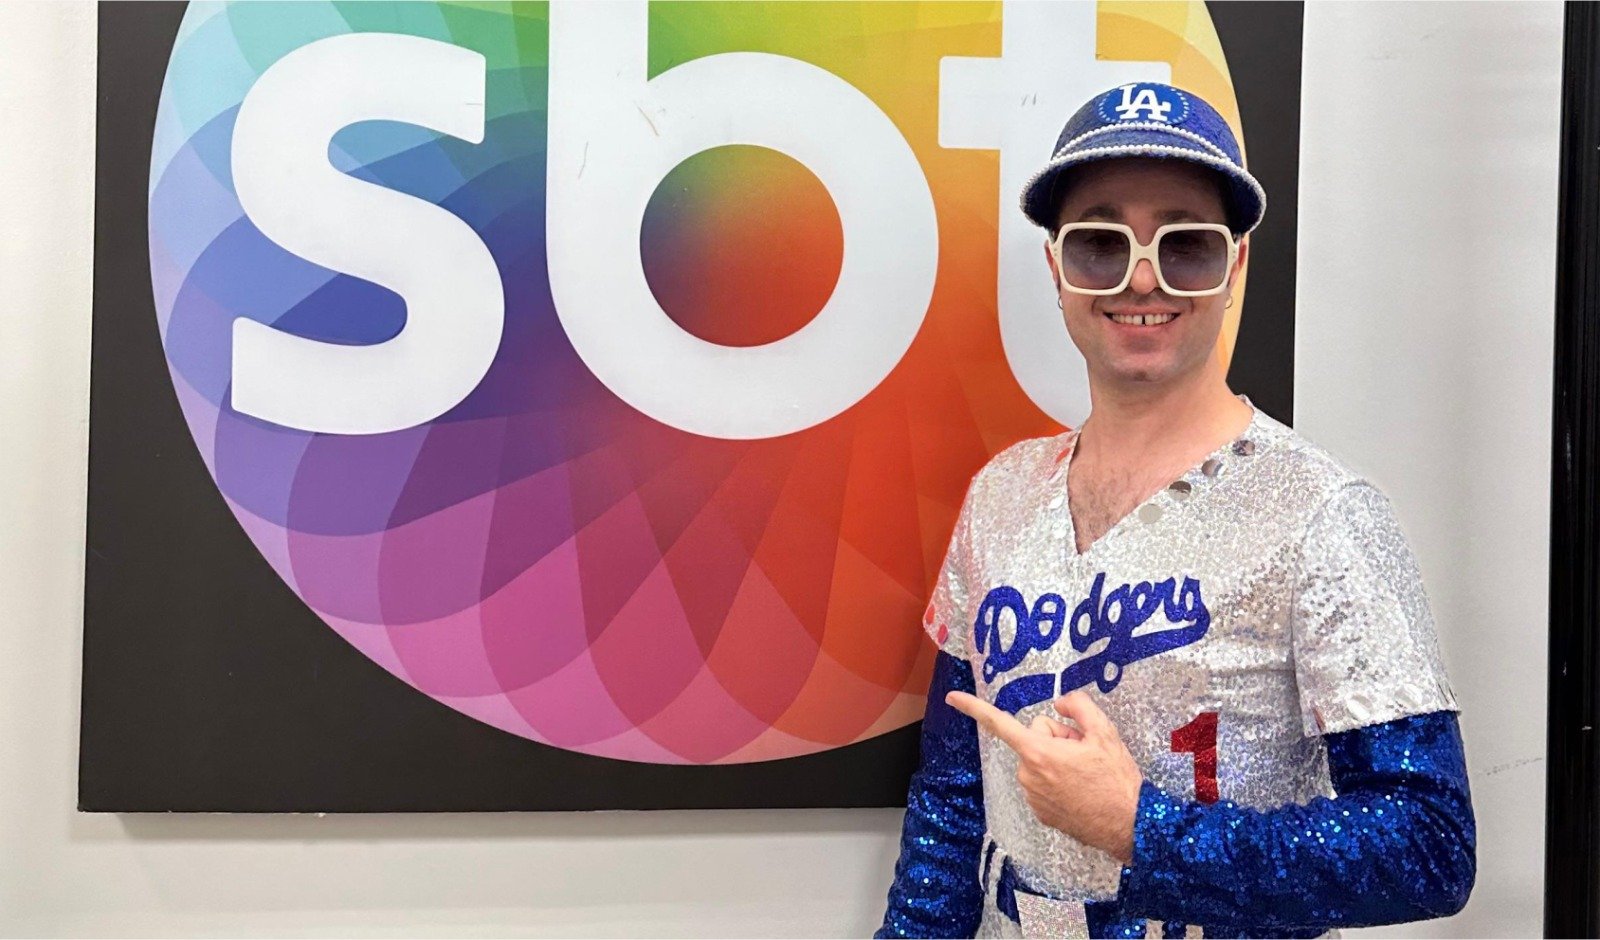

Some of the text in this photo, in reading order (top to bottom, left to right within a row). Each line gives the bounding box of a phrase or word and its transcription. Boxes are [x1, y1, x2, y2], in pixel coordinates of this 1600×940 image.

[1115, 84, 1171, 121] LA
[231, 0, 1170, 440] sbt
[974, 572, 1210, 694] Dodgers
[1171, 711, 1219, 804] 1
